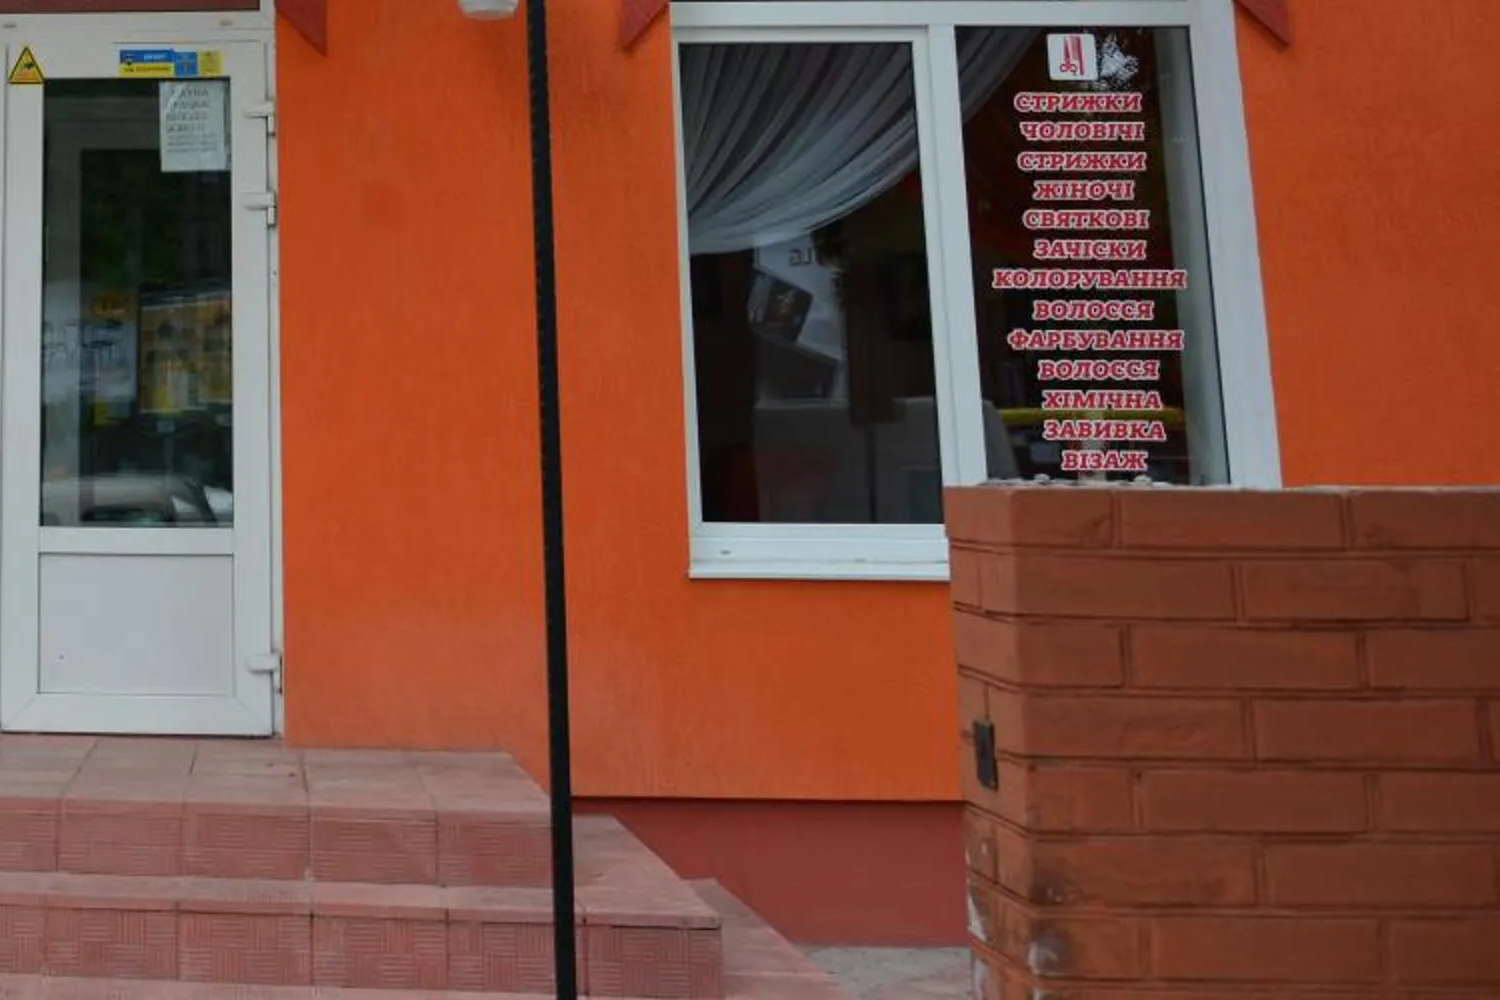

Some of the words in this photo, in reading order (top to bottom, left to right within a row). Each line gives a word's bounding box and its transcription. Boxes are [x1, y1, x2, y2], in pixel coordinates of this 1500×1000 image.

[1014, 92, 1143, 112] СТРИЖКИ
[1020, 121, 1145, 140] ЧОЛОВІЧІ
[1017, 152, 1147, 170] СТРИЖКИ
[1033, 180, 1135, 200] ЖІНОЧІ
[1023, 209, 1150, 229] СВЯТКОВІ
[1033, 239, 1147, 260] ЗАЧІСКИ
[993, 269, 1187, 289] КОЛОРУВАННЯ
[1033, 300, 1154, 320] ВОЛОССЯ
[1007, 329, 1185, 349] ФАРБУВАННЯ
[1038, 360, 1160, 380] ВОЛОССЯ
[1043, 390, 1163, 410] ХІМІЧНА
[1043, 420, 1167, 440] ЗАВИВКА
[1061, 450, 1148, 470] ВІЗАЖ
